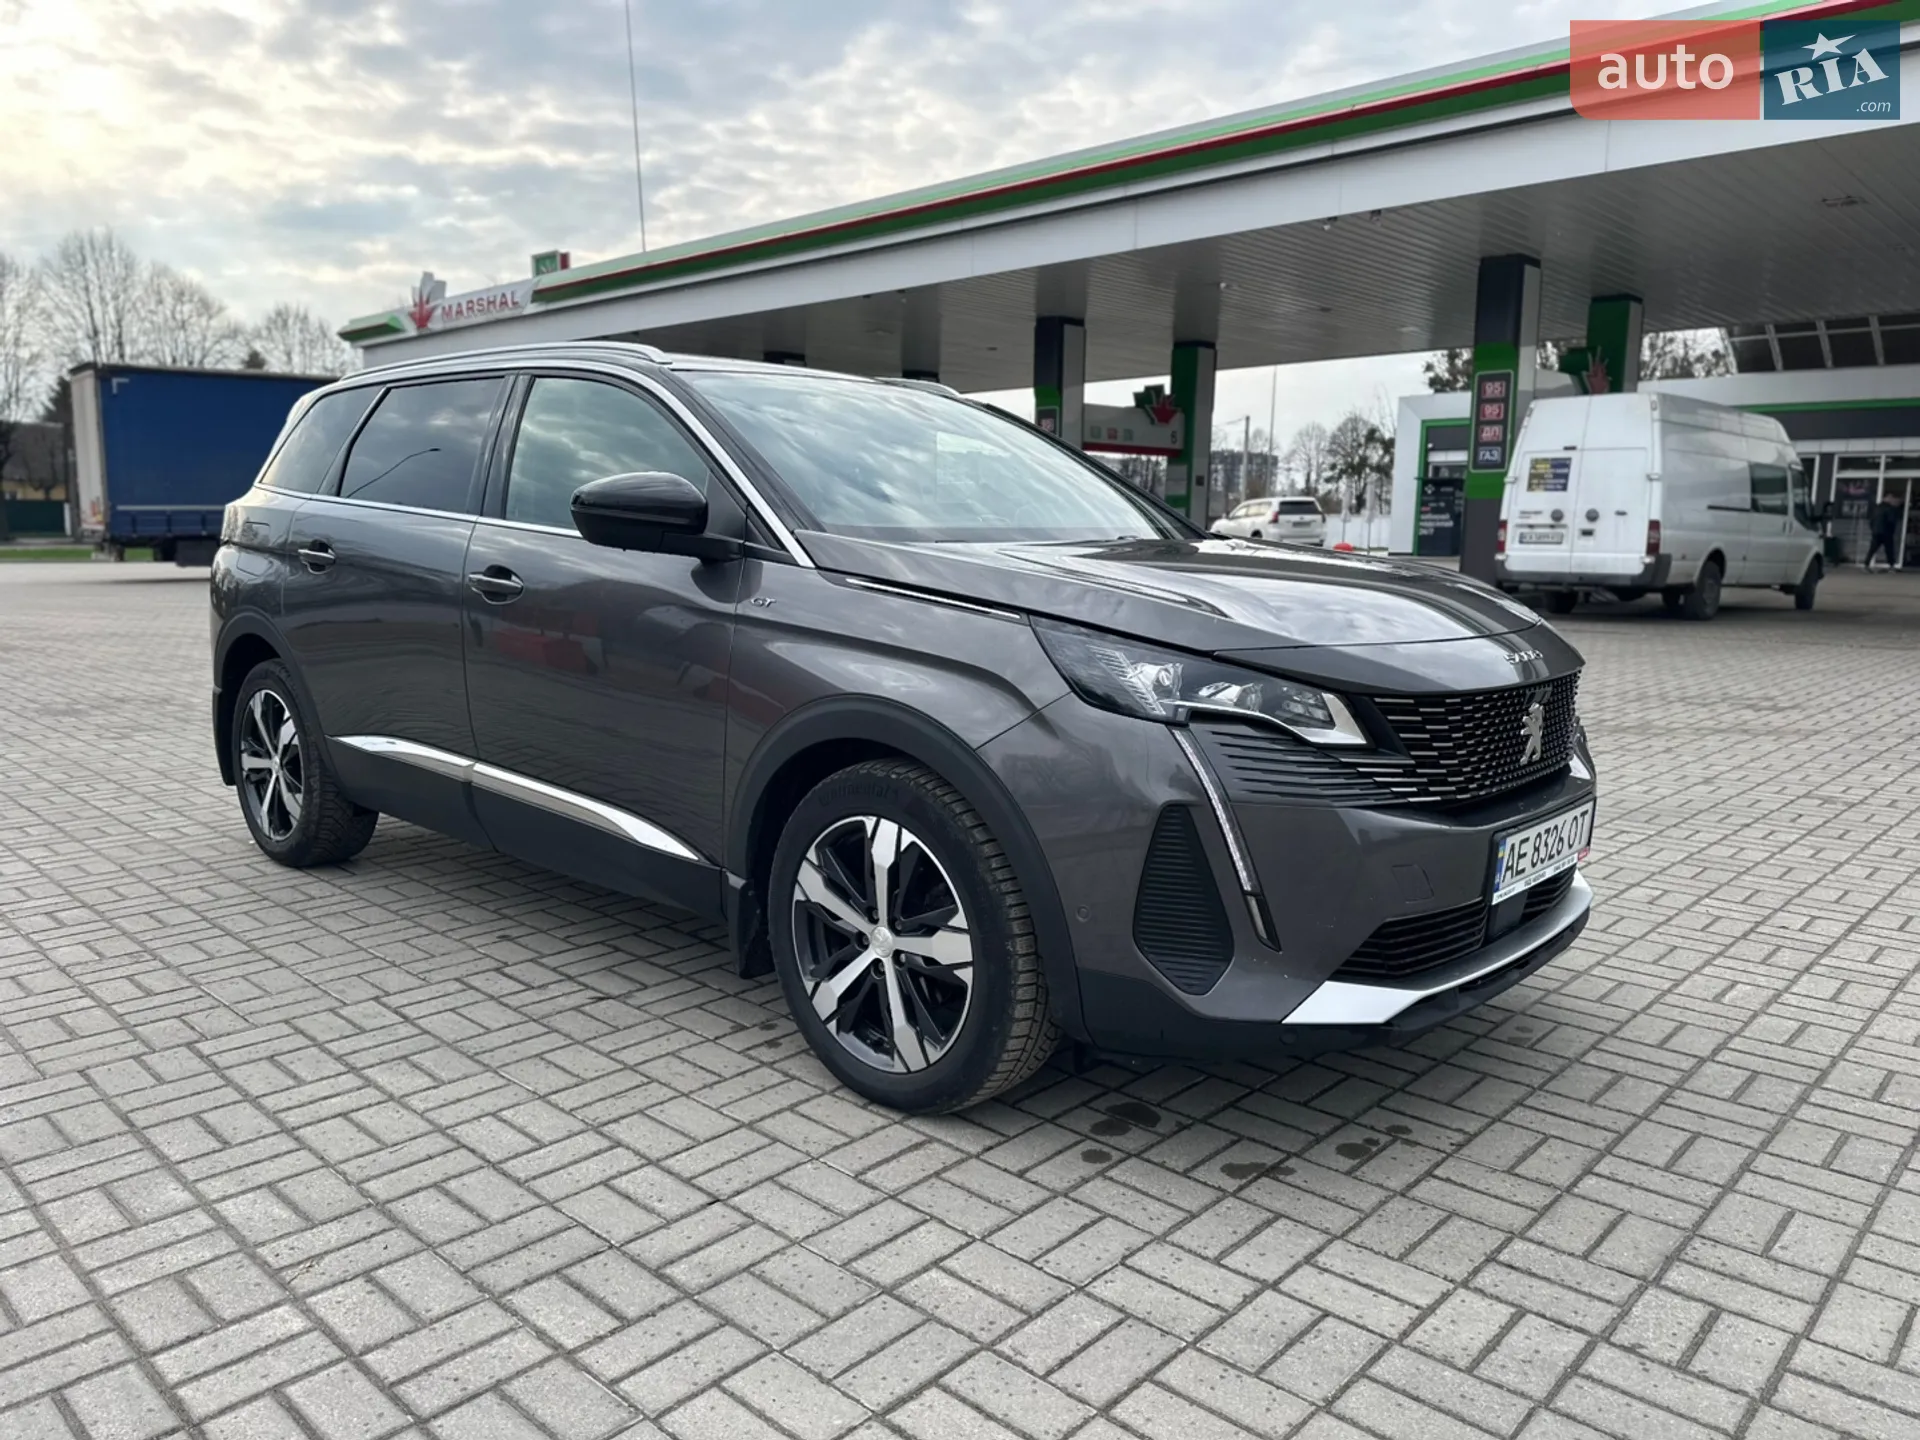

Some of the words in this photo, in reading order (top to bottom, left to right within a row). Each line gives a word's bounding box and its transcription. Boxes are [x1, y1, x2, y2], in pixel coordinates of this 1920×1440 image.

[442, 291, 519, 319] MARSHAL
[1479, 450, 1498, 461] ГАЗ
[751, 597, 777, 608] GT
[1502, 836, 1530, 883] AE
[1531, 820, 1567, 868] 8326
[1568, 809, 1589, 850] OT
